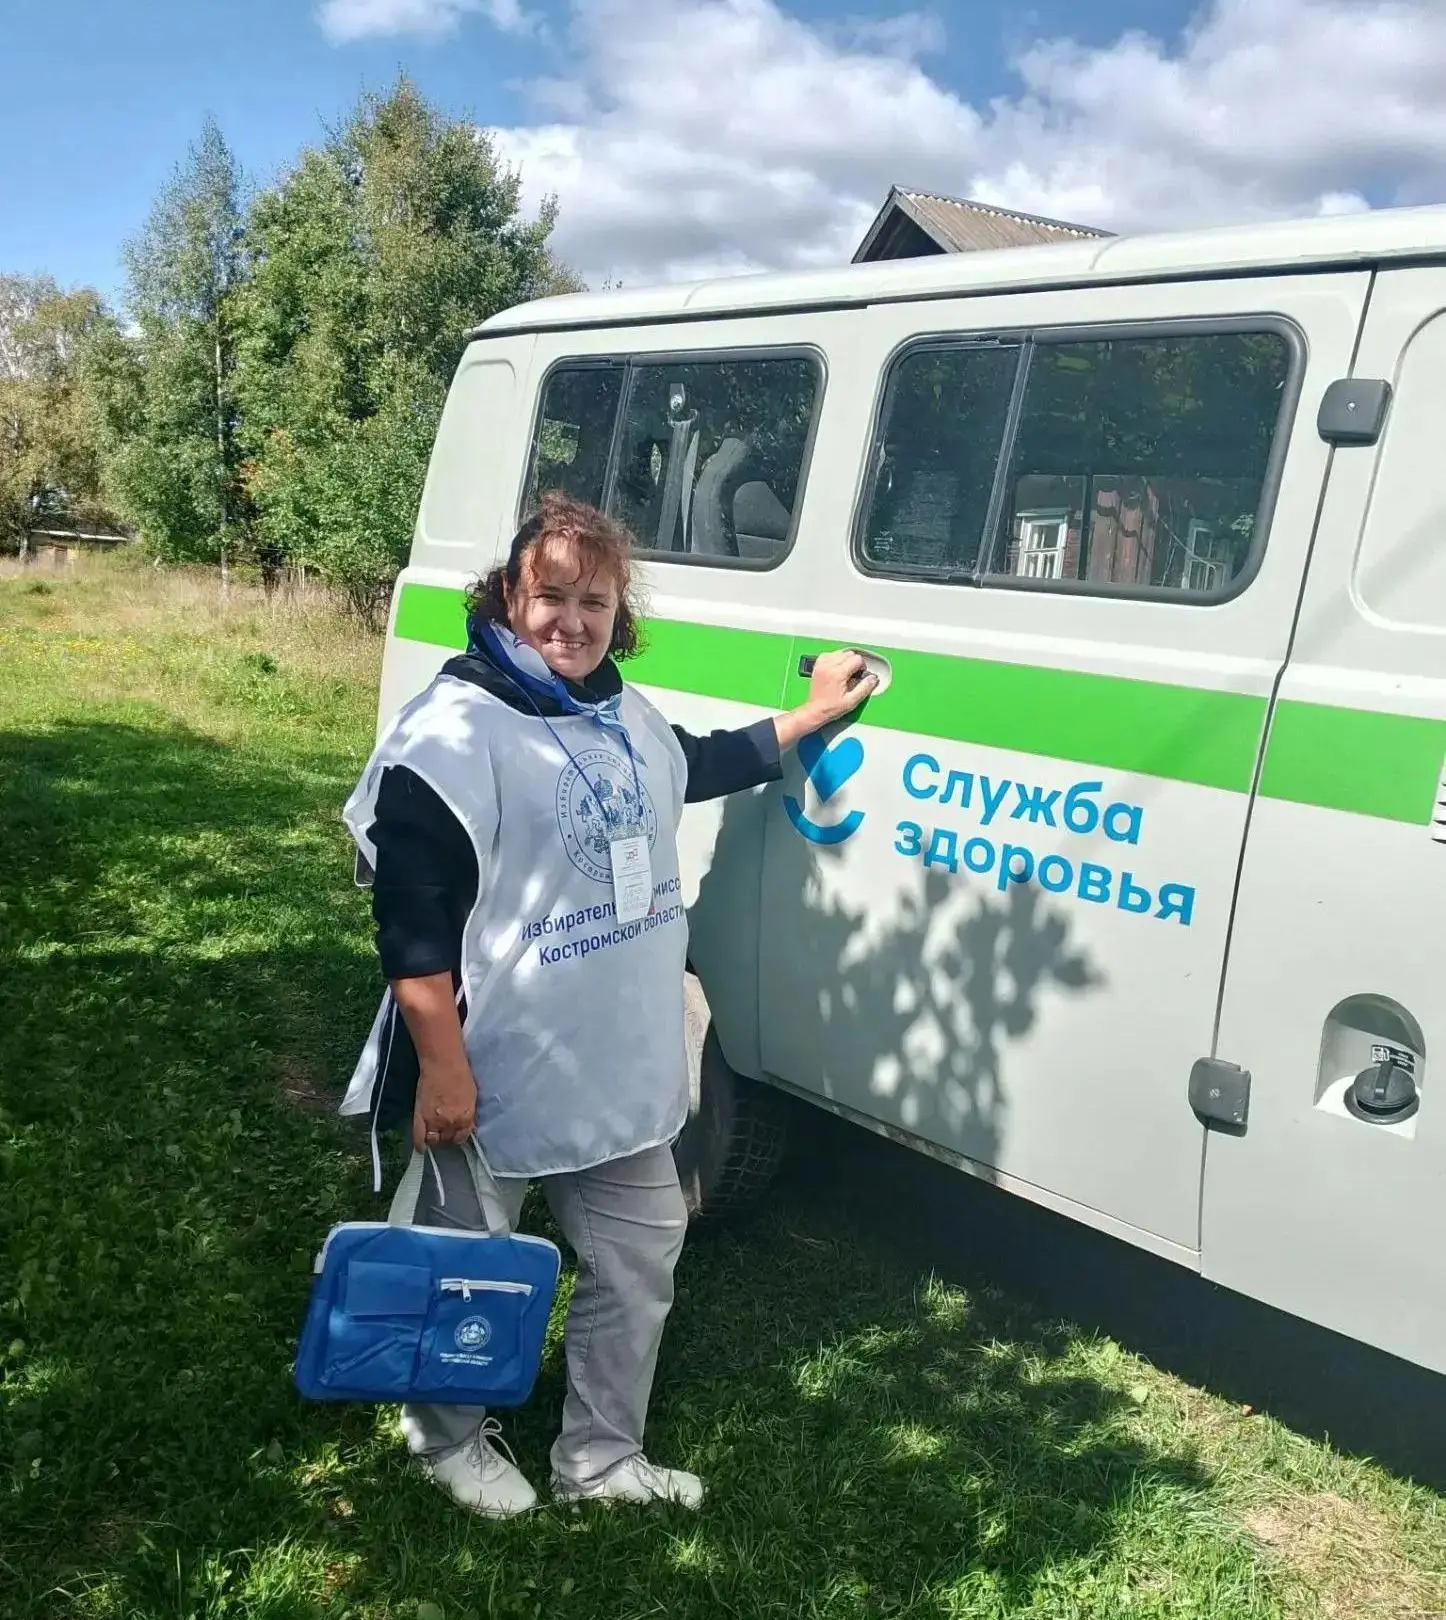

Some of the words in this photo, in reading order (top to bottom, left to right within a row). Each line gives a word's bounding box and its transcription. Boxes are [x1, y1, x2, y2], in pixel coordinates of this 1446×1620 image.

[902, 753, 1144, 846] Служба
[894, 820, 1196, 926] здоровья
[521, 901, 617, 941] Избиратель
